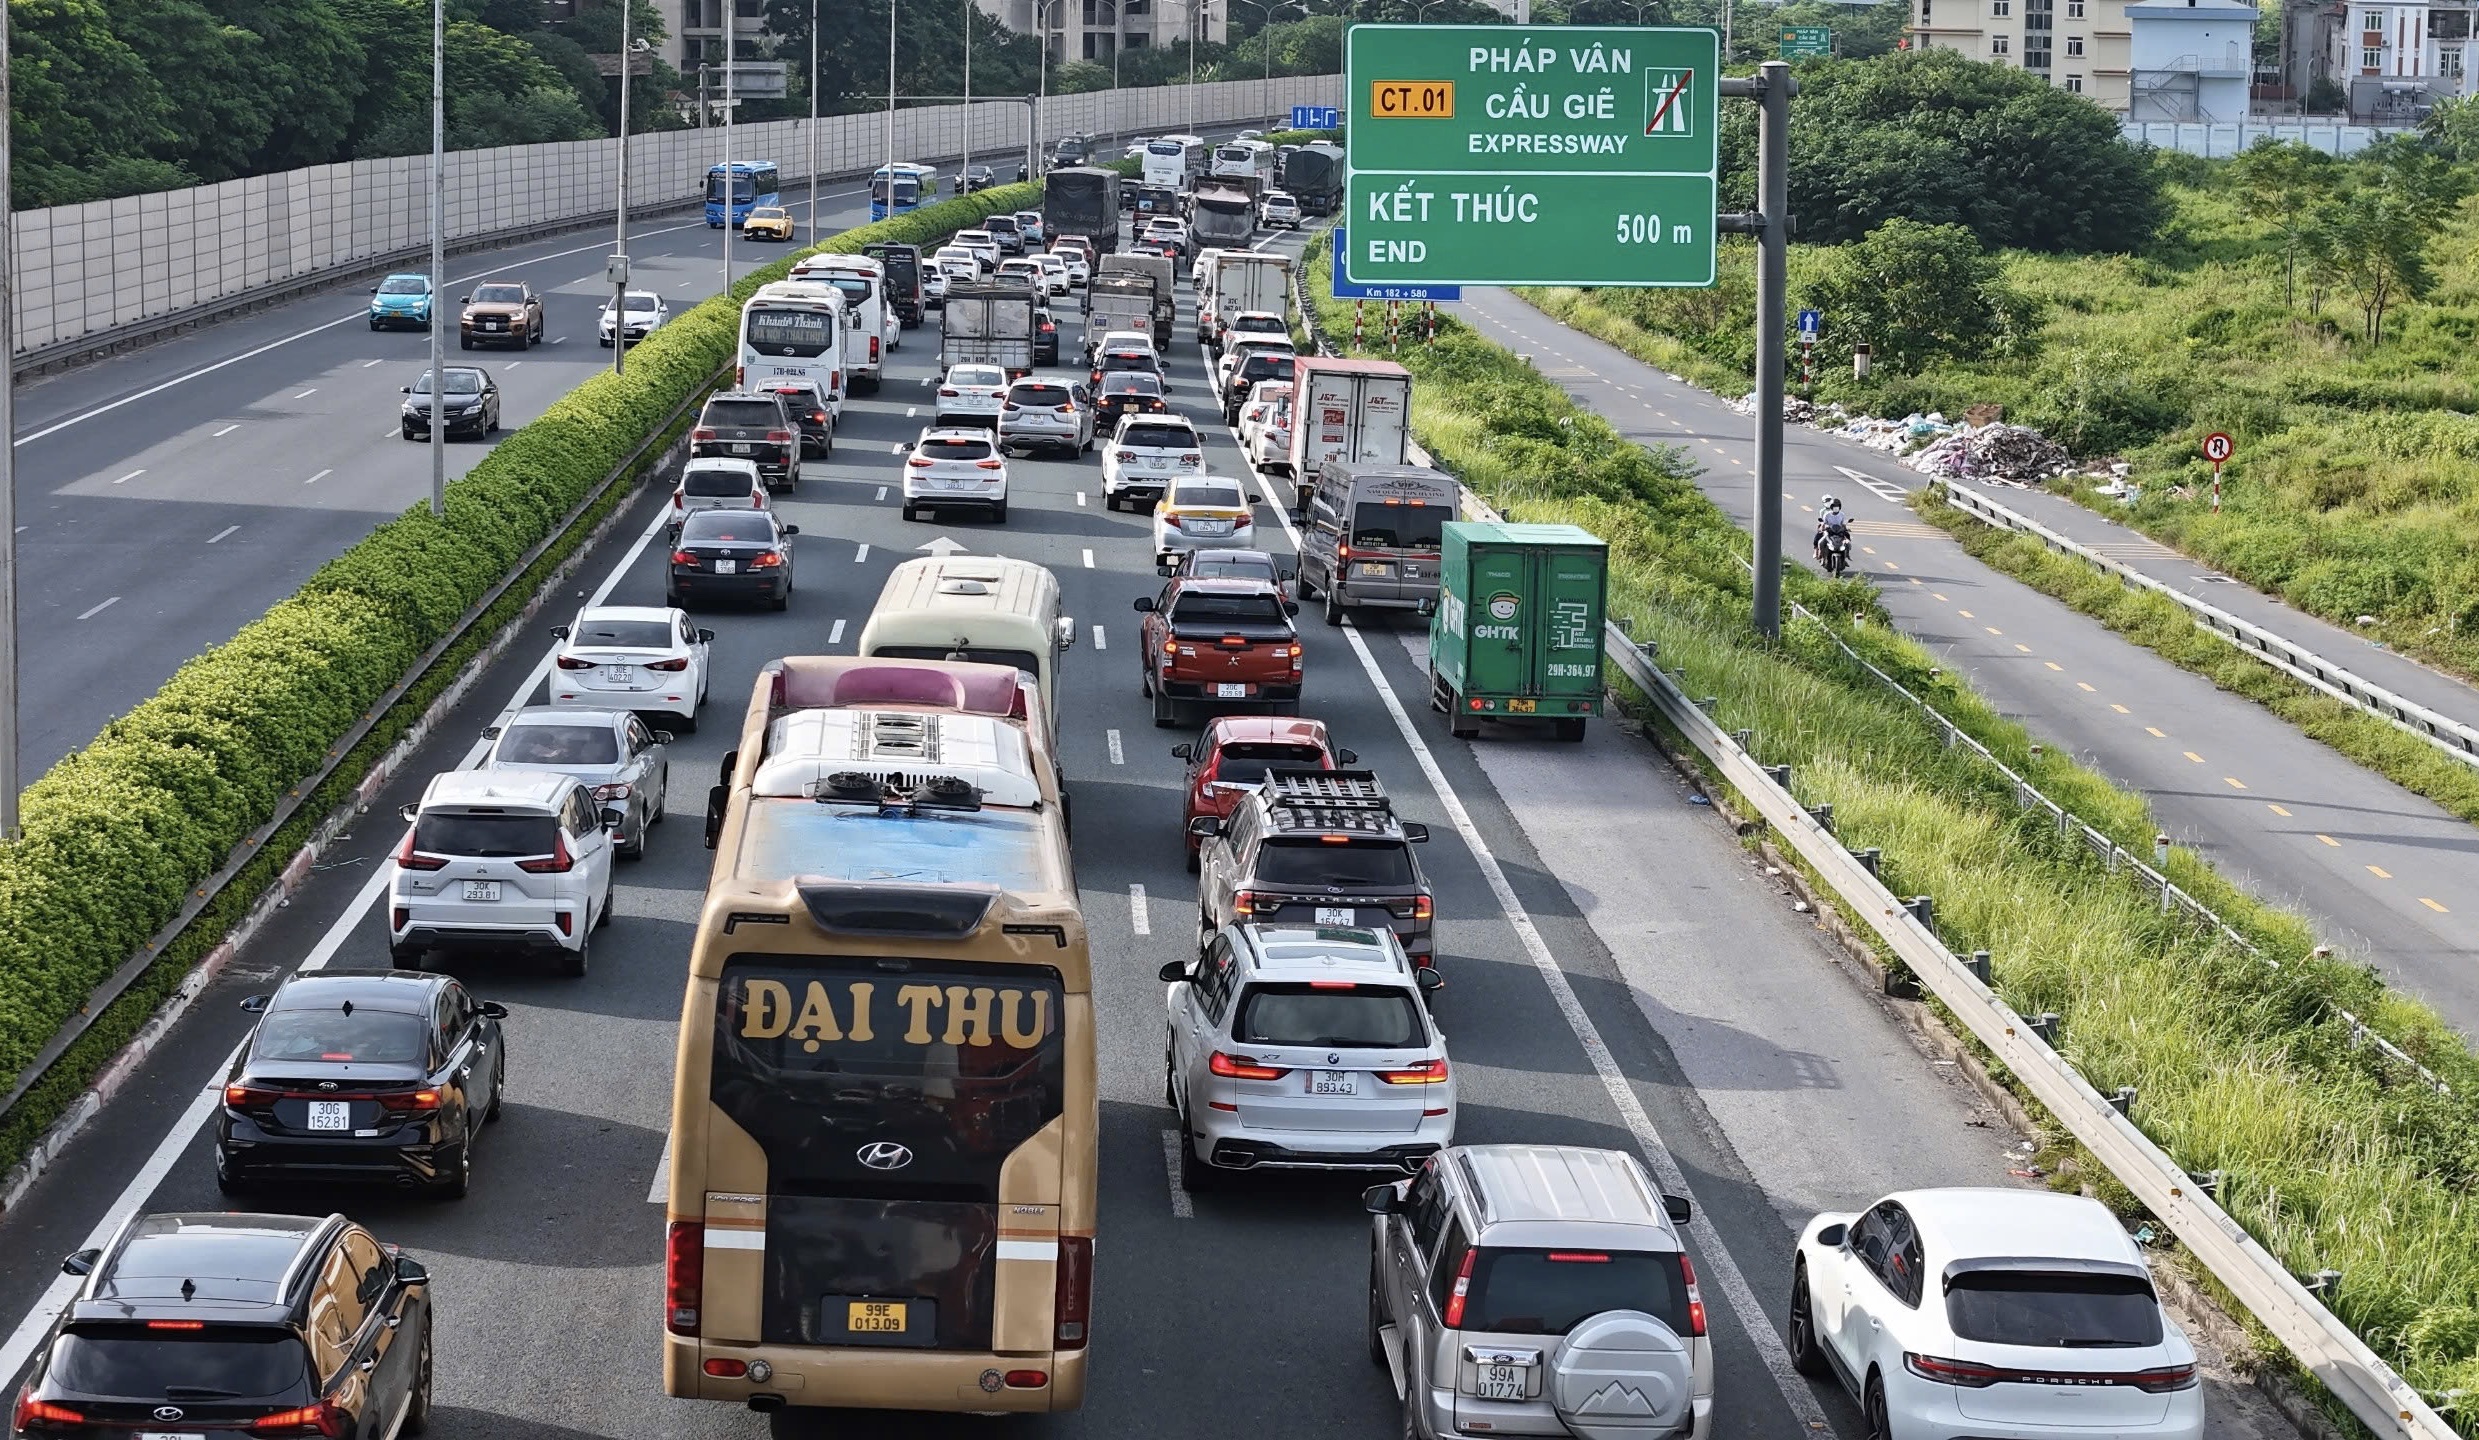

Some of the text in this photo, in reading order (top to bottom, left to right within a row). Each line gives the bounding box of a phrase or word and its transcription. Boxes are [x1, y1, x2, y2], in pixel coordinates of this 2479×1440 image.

[1469, 38, 1631, 74] PHÁP VÂN
[1381, 87, 1445, 112] CT.01
[1485, 82, 1615, 119] CẦU GIẼ
[1468, 134, 1629, 154] EXPRESSWAY
[1369, 179, 1539, 223] KẾT THÚC
[1616, 214, 1692, 244] 500 m
[1369, 240, 1427, 262] END
[1366, 288, 1382, 297] Km
[1385, 289, 1400, 298] 182
[1411, 289, 1427, 298] 580
[1368, 396, 1387, 404] J&T
[1474, 624, 1519, 640] GHTK
[1548, 664, 1596, 678] 29H-364.97
[474, 882, 490, 890] 30K
[1327, 908, 1343, 918] 30K
[740, 979, 1049, 1053] ĐẠI THU
[1326, 1072, 1344, 1082] 30H
[1317, 1082, 1352, 1093] 893.43
[318, 1103, 340, 1115] 30G
[312, 1116, 346, 1128] 152.81
[1014, 1206, 1045, 1216] NOBLE
[866, 1304, 890, 1316] 99E
[855, 1318, 900, 1330] 013.09
[1490, 1366, 1514, 1382] 99A
[2022, 1376, 2113, 1385] PORSCHE
[1478, 1382, 1524, 1398] 017.74
